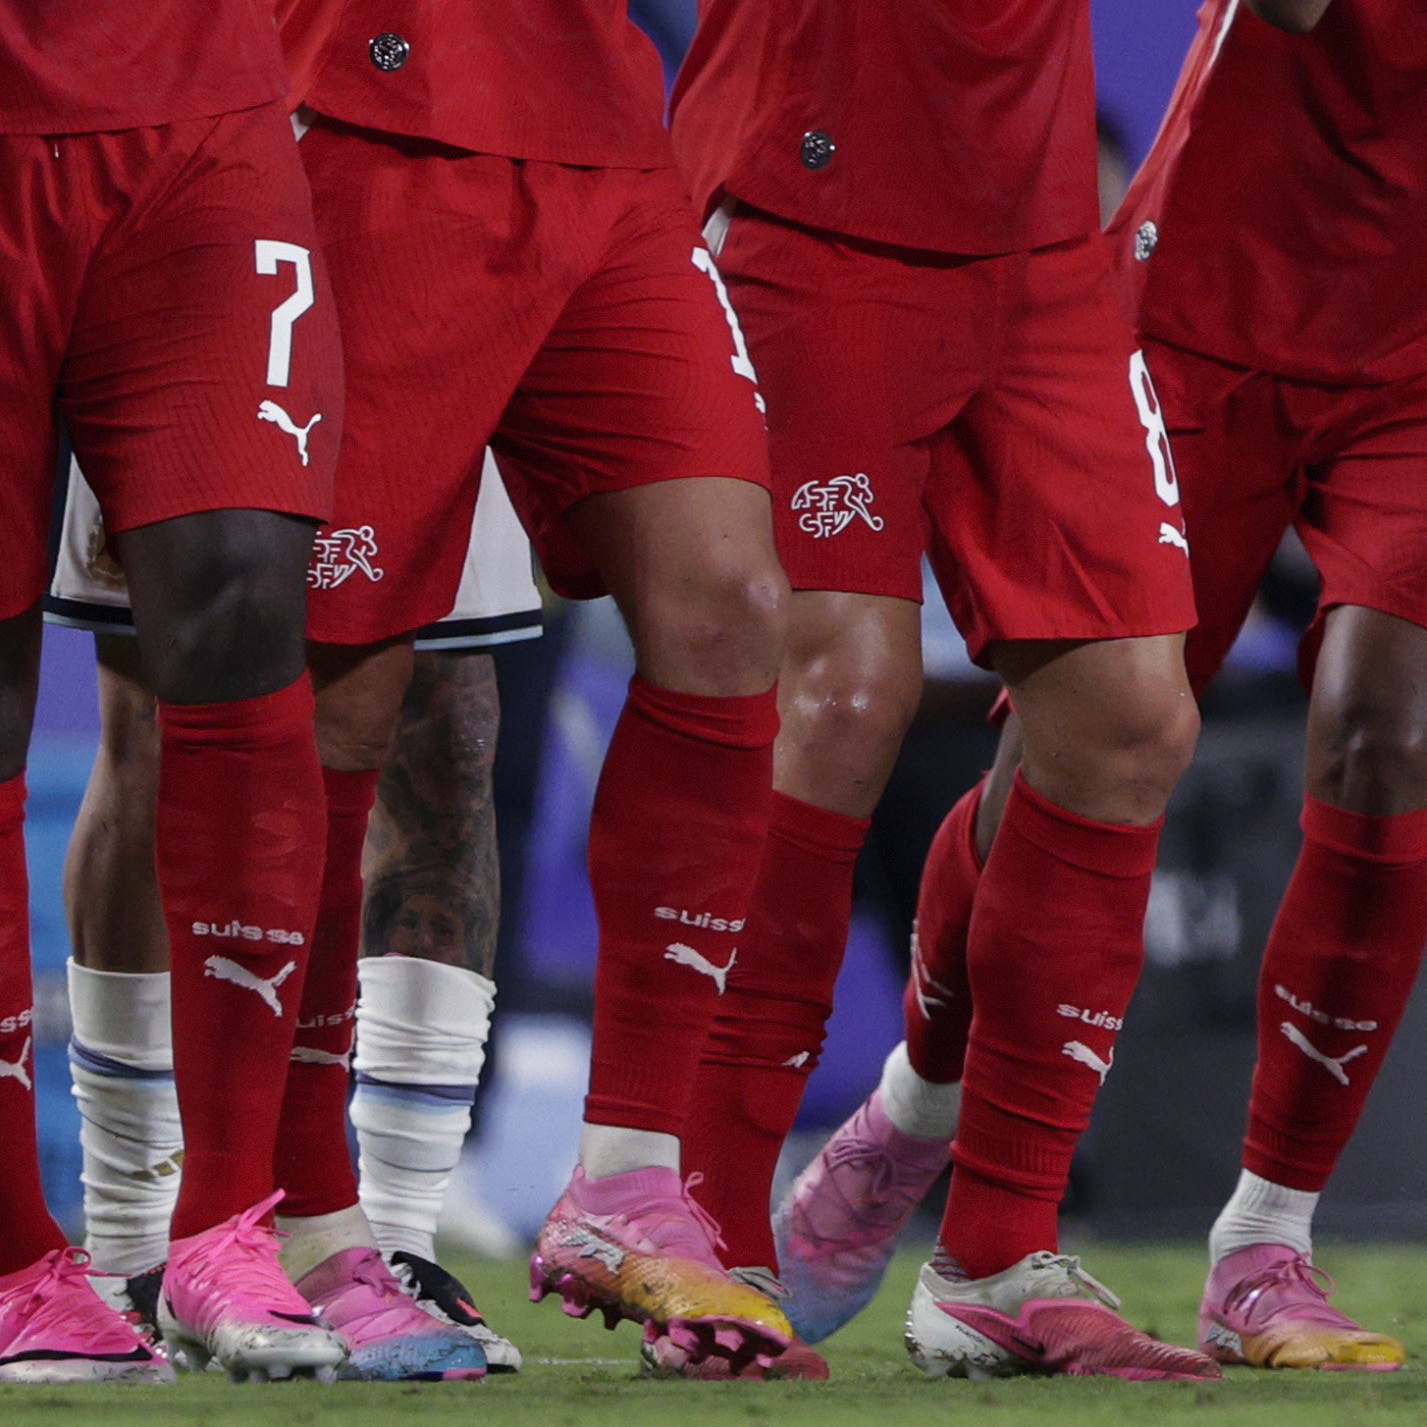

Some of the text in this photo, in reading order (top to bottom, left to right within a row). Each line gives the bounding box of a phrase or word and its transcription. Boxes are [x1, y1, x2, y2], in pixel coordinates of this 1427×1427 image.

[255, 239, 315, 388] 7
[1128, 348, 1180, 507] 8
[192, 919, 305, 946] suisse
[654, 906, 746, 932] suiss
